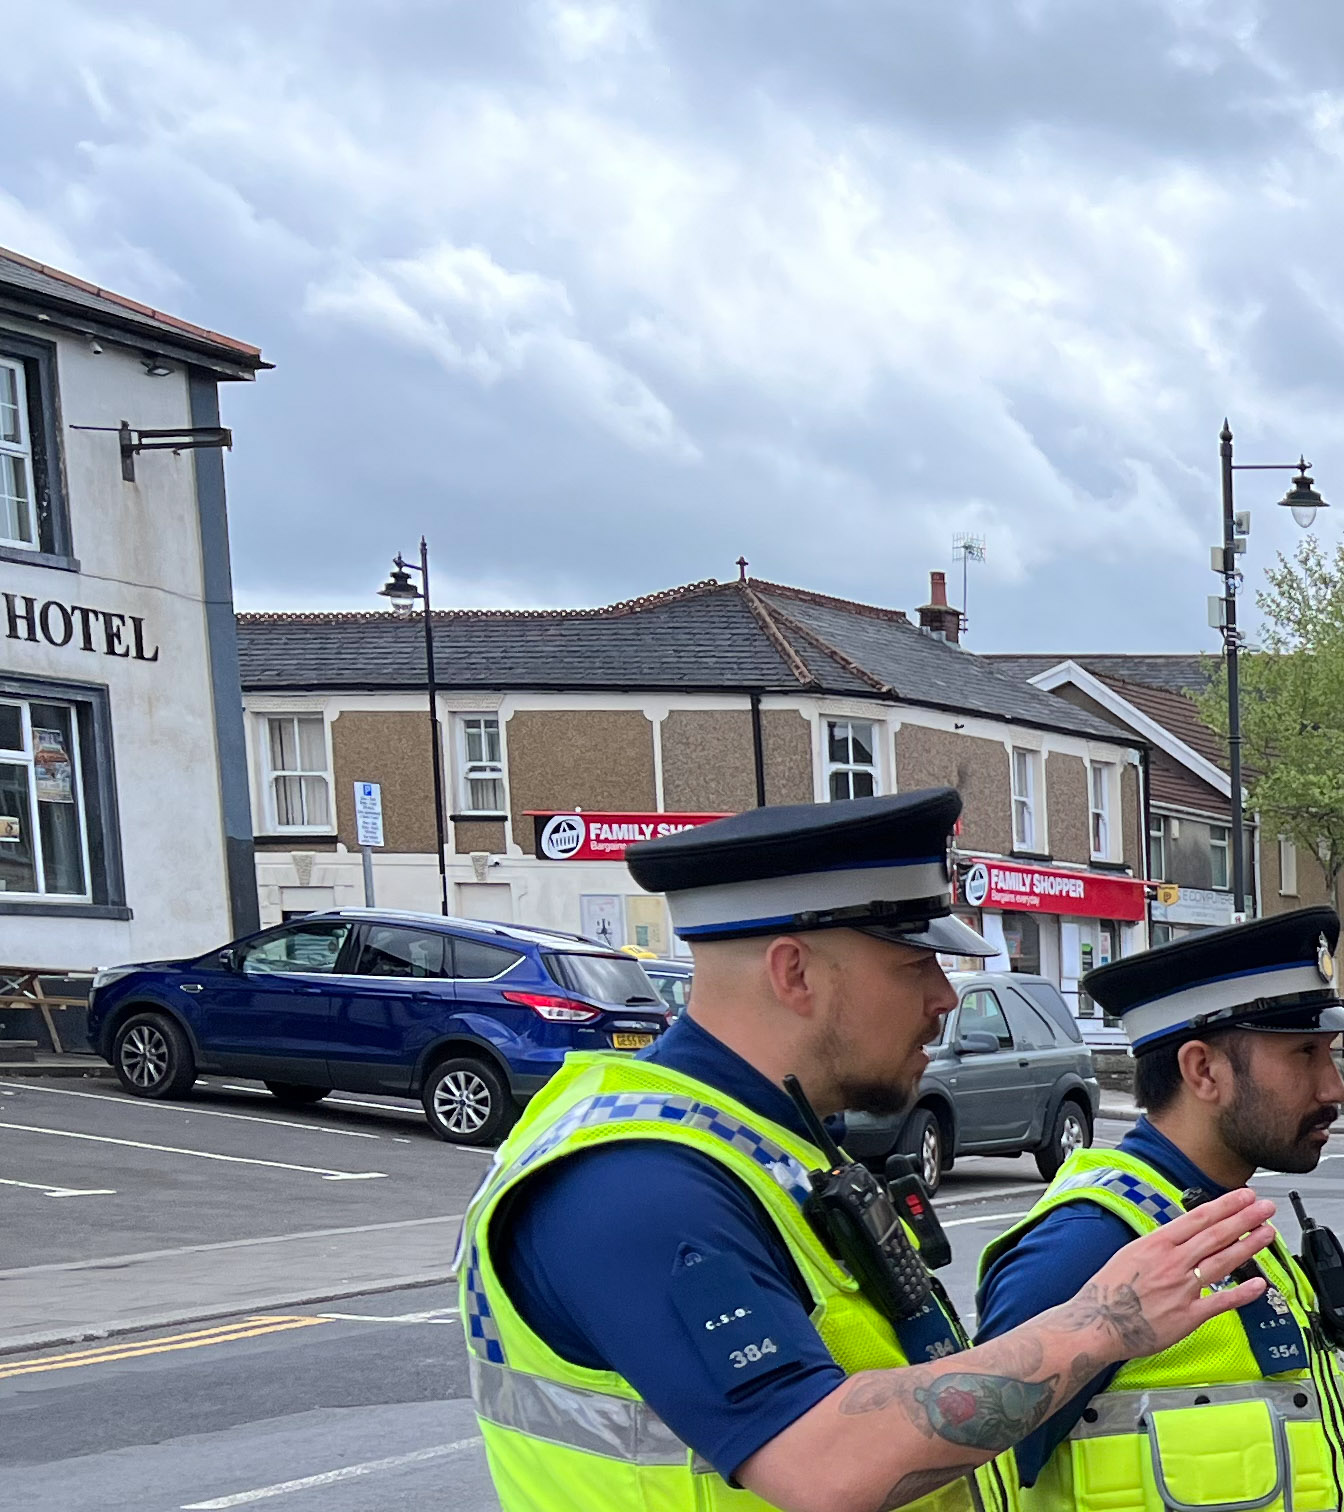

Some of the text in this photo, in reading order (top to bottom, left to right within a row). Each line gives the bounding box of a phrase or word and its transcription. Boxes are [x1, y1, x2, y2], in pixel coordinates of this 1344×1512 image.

[1, 592, 159, 662] HOTEL
[589, 823, 654, 840] FAMILY
[990, 869, 1084, 898] FAMILY SHOPPER
[705, 1307, 752, 1331] C.S.O.
[728, 1337, 777, 1368] 384
[925, 1337, 955, 1360] 384
[1268, 1343, 1299, 1359] 354
